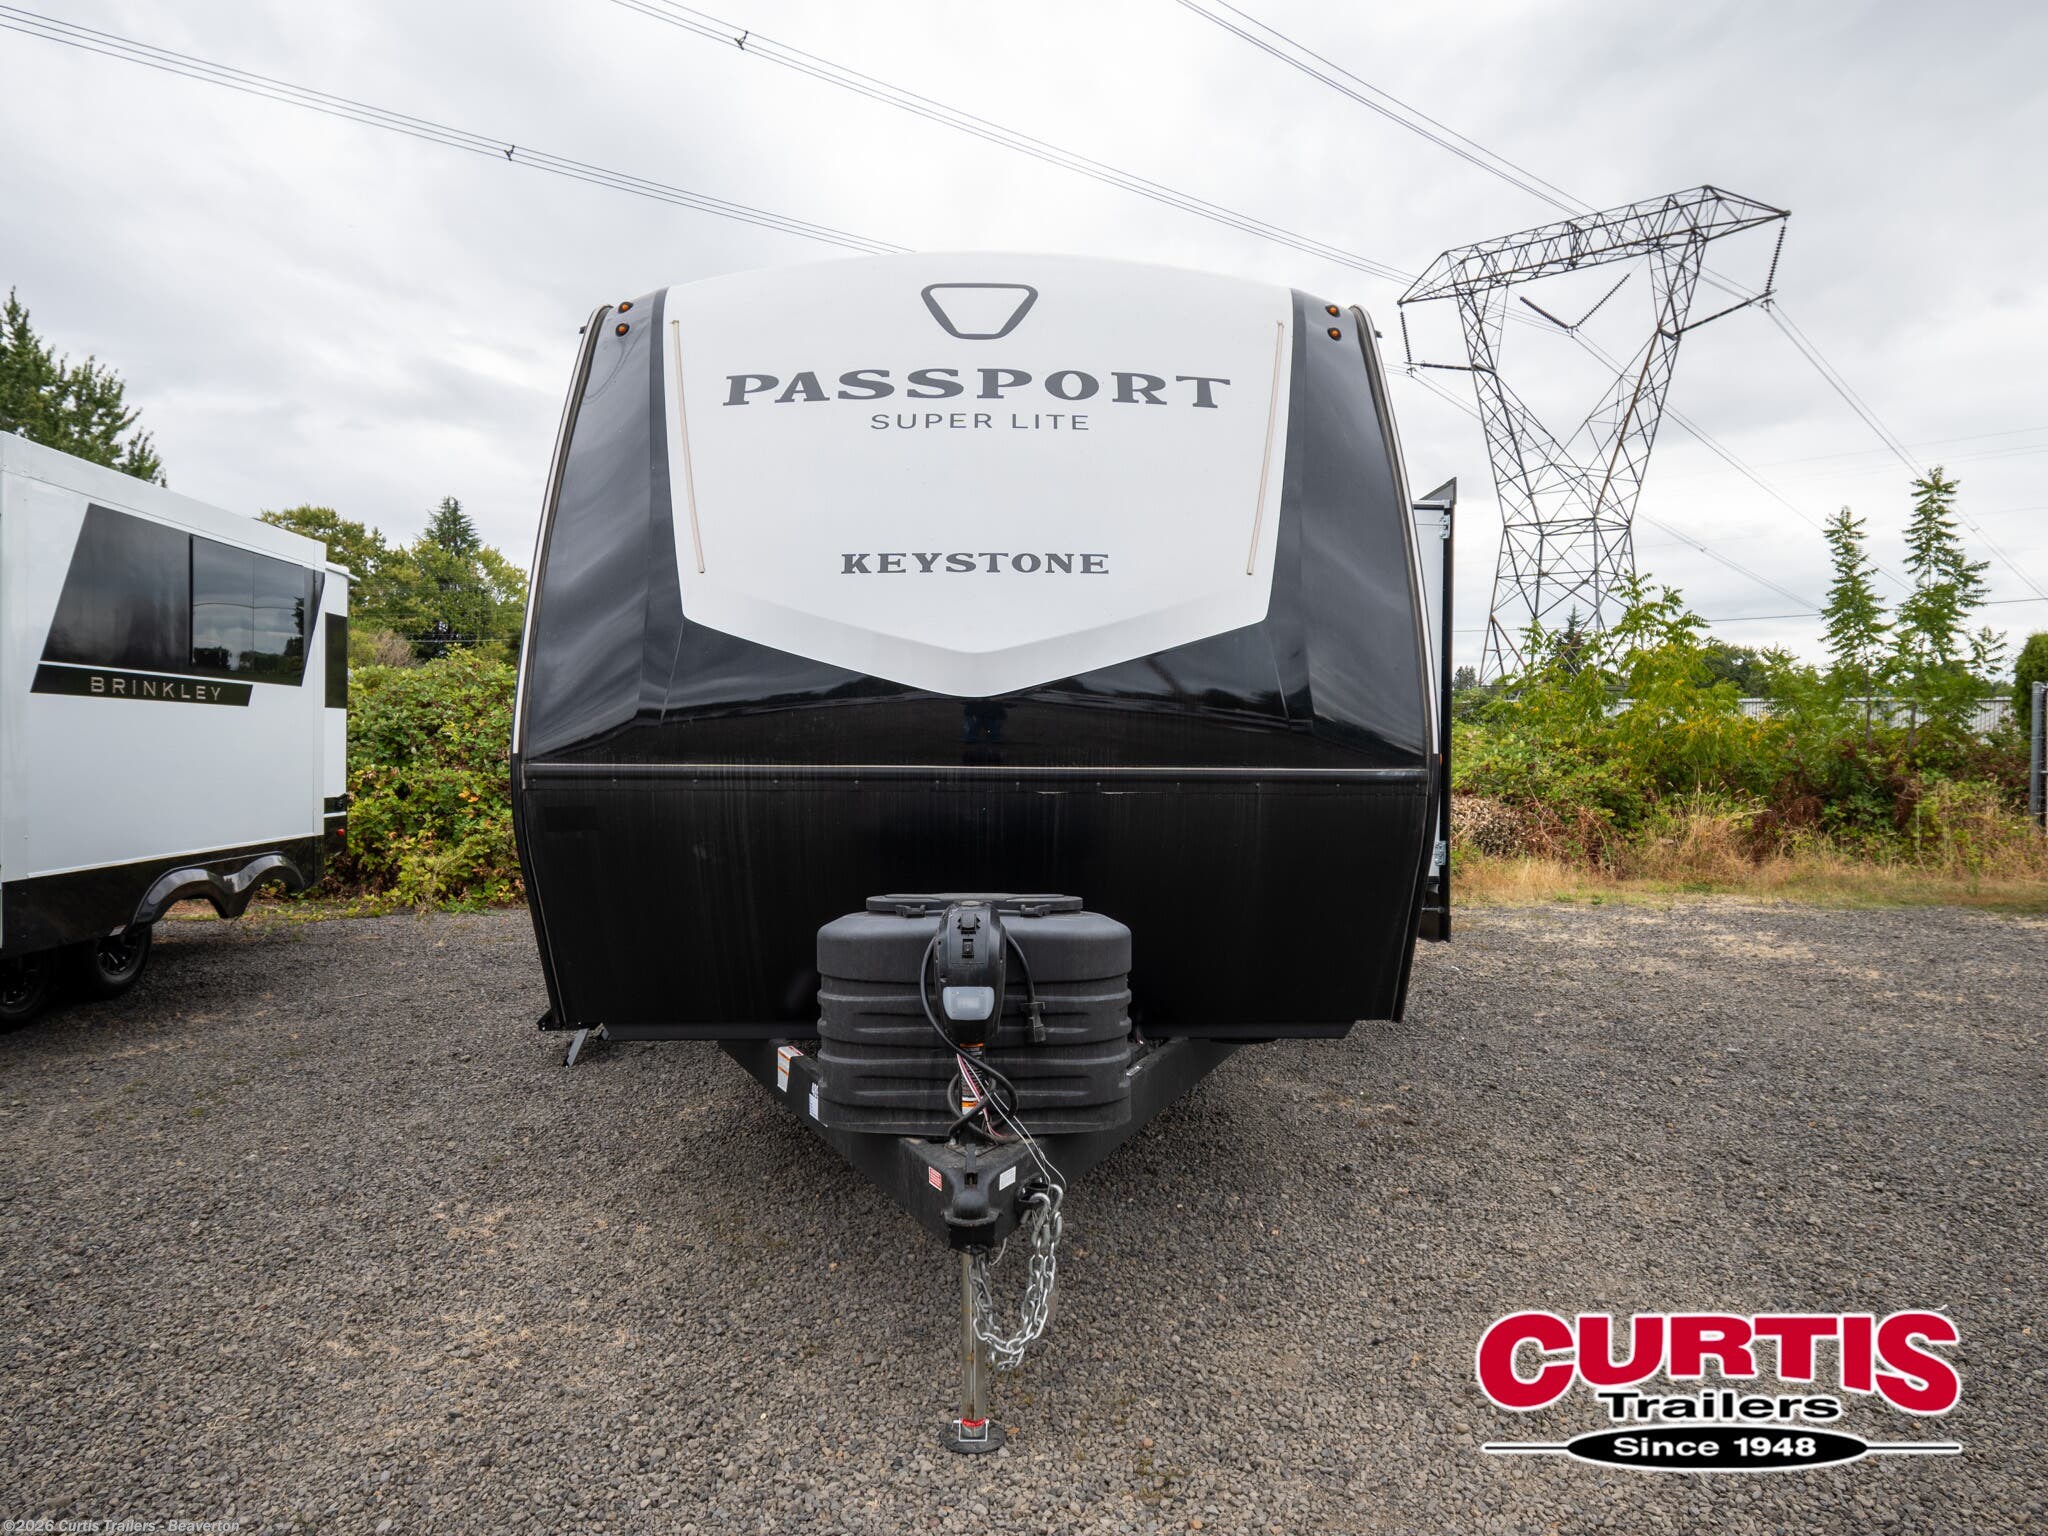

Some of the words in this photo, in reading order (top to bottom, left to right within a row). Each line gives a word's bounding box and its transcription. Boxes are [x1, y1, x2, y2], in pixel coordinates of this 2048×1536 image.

[722, 367, 1232, 409] PASSPORT
[870, 412, 993, 431] SUPER
[1011, 412, 1090, 431] LITE
[840, 552, 1110, 575] KEYSTONE
[89, 676, 223, 701] BRINKLEY
